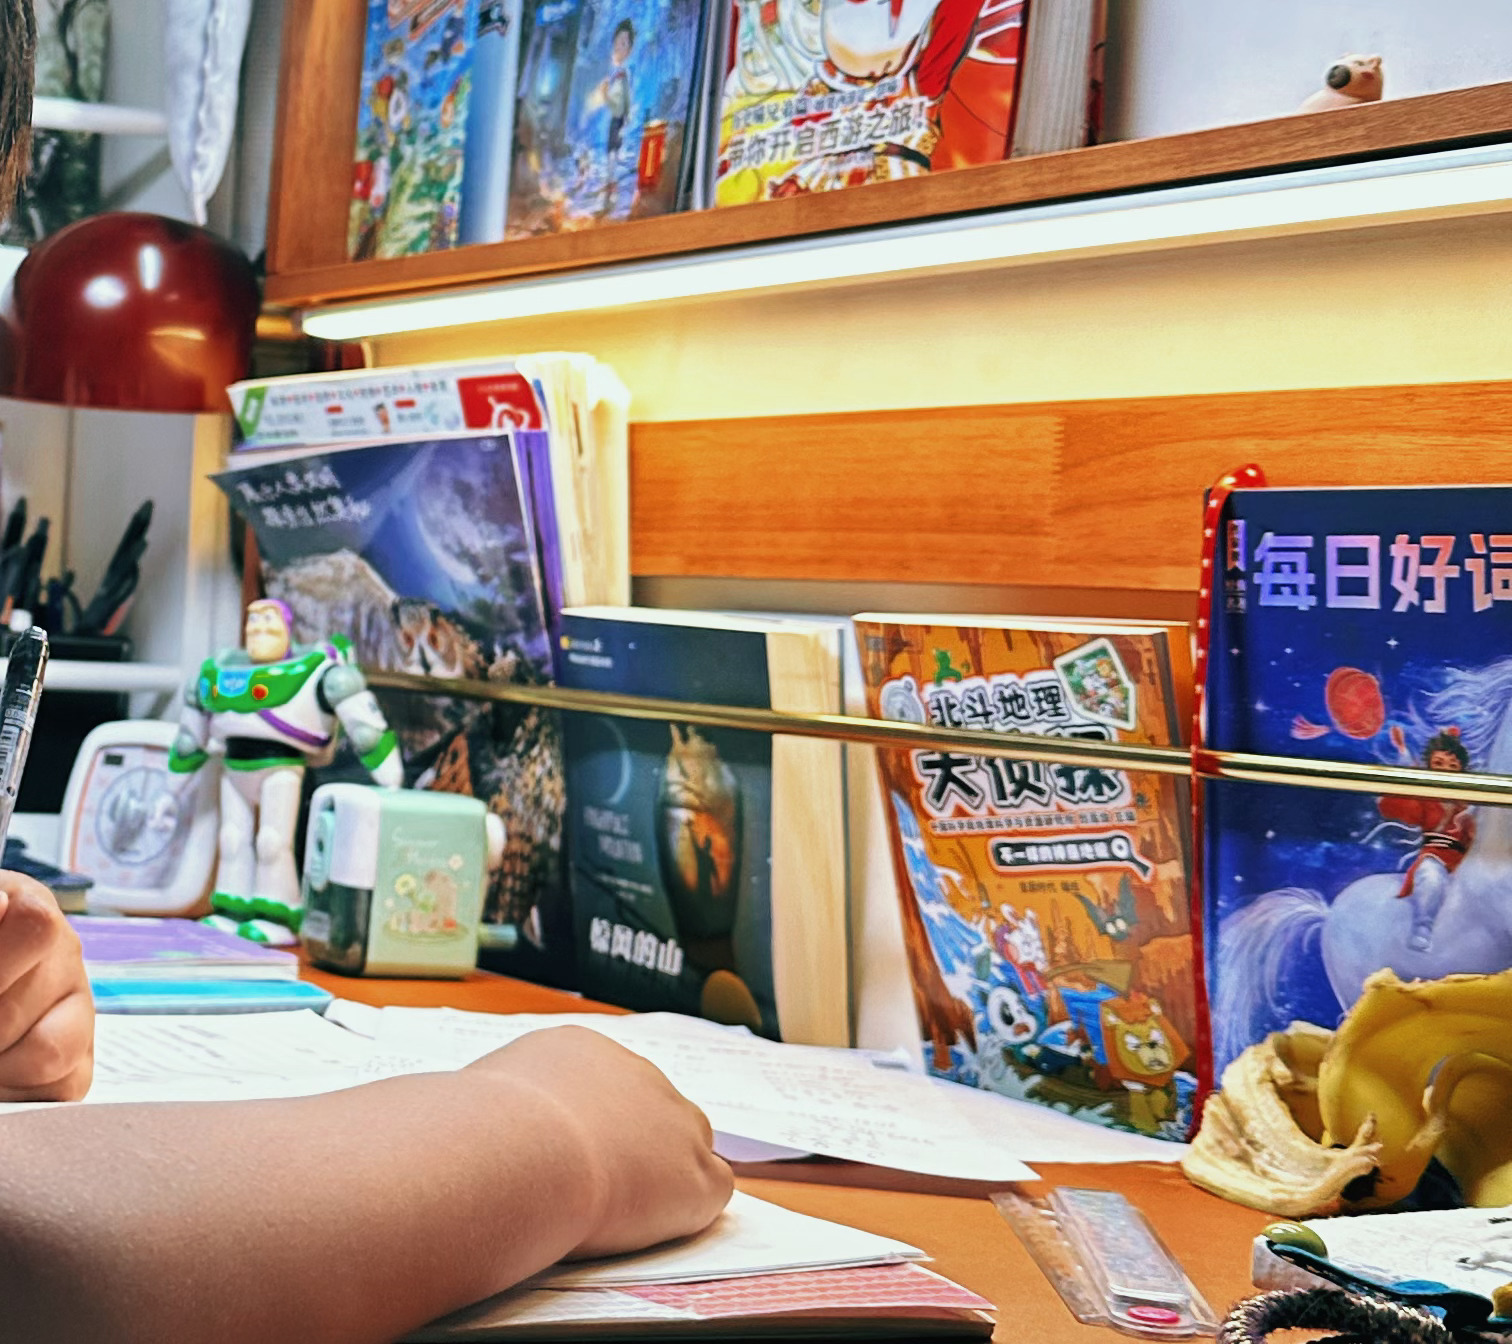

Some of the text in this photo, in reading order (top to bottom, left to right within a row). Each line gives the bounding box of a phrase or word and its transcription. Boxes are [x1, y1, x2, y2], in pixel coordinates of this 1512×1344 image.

[1252, 531, 1512, 614] 每日好词
[929, 684, 1067, 729] 北斗地理
